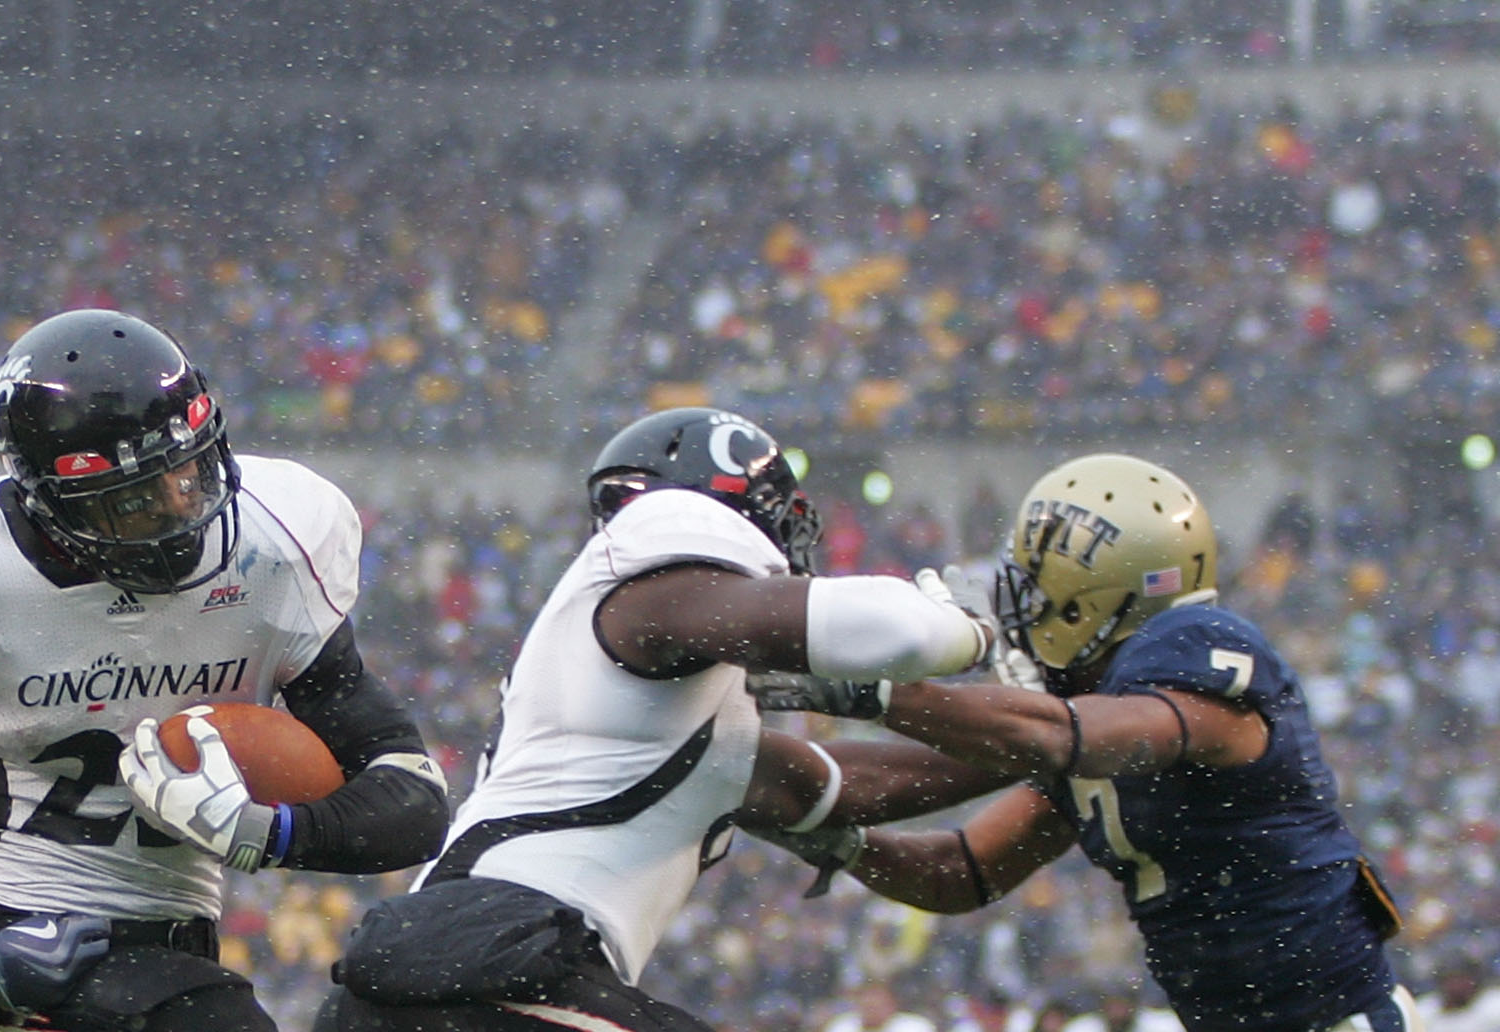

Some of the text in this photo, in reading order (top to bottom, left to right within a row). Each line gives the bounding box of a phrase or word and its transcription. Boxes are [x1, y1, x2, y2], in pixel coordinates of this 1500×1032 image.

[708, 424, 755, 476] C
[1023, 500, 1122, 569] PITT
[210, 584, 242, 598] BIG
[1192, 552, 1206, 590] 7
[106, 604, 146, 615] adidas
[16, 656, 249, 708] CINCINNATI
[1210, 648, 1255, 698] 7
[18, 728, 181, 848] 2
[1069, 777, 1167, 904] 7
